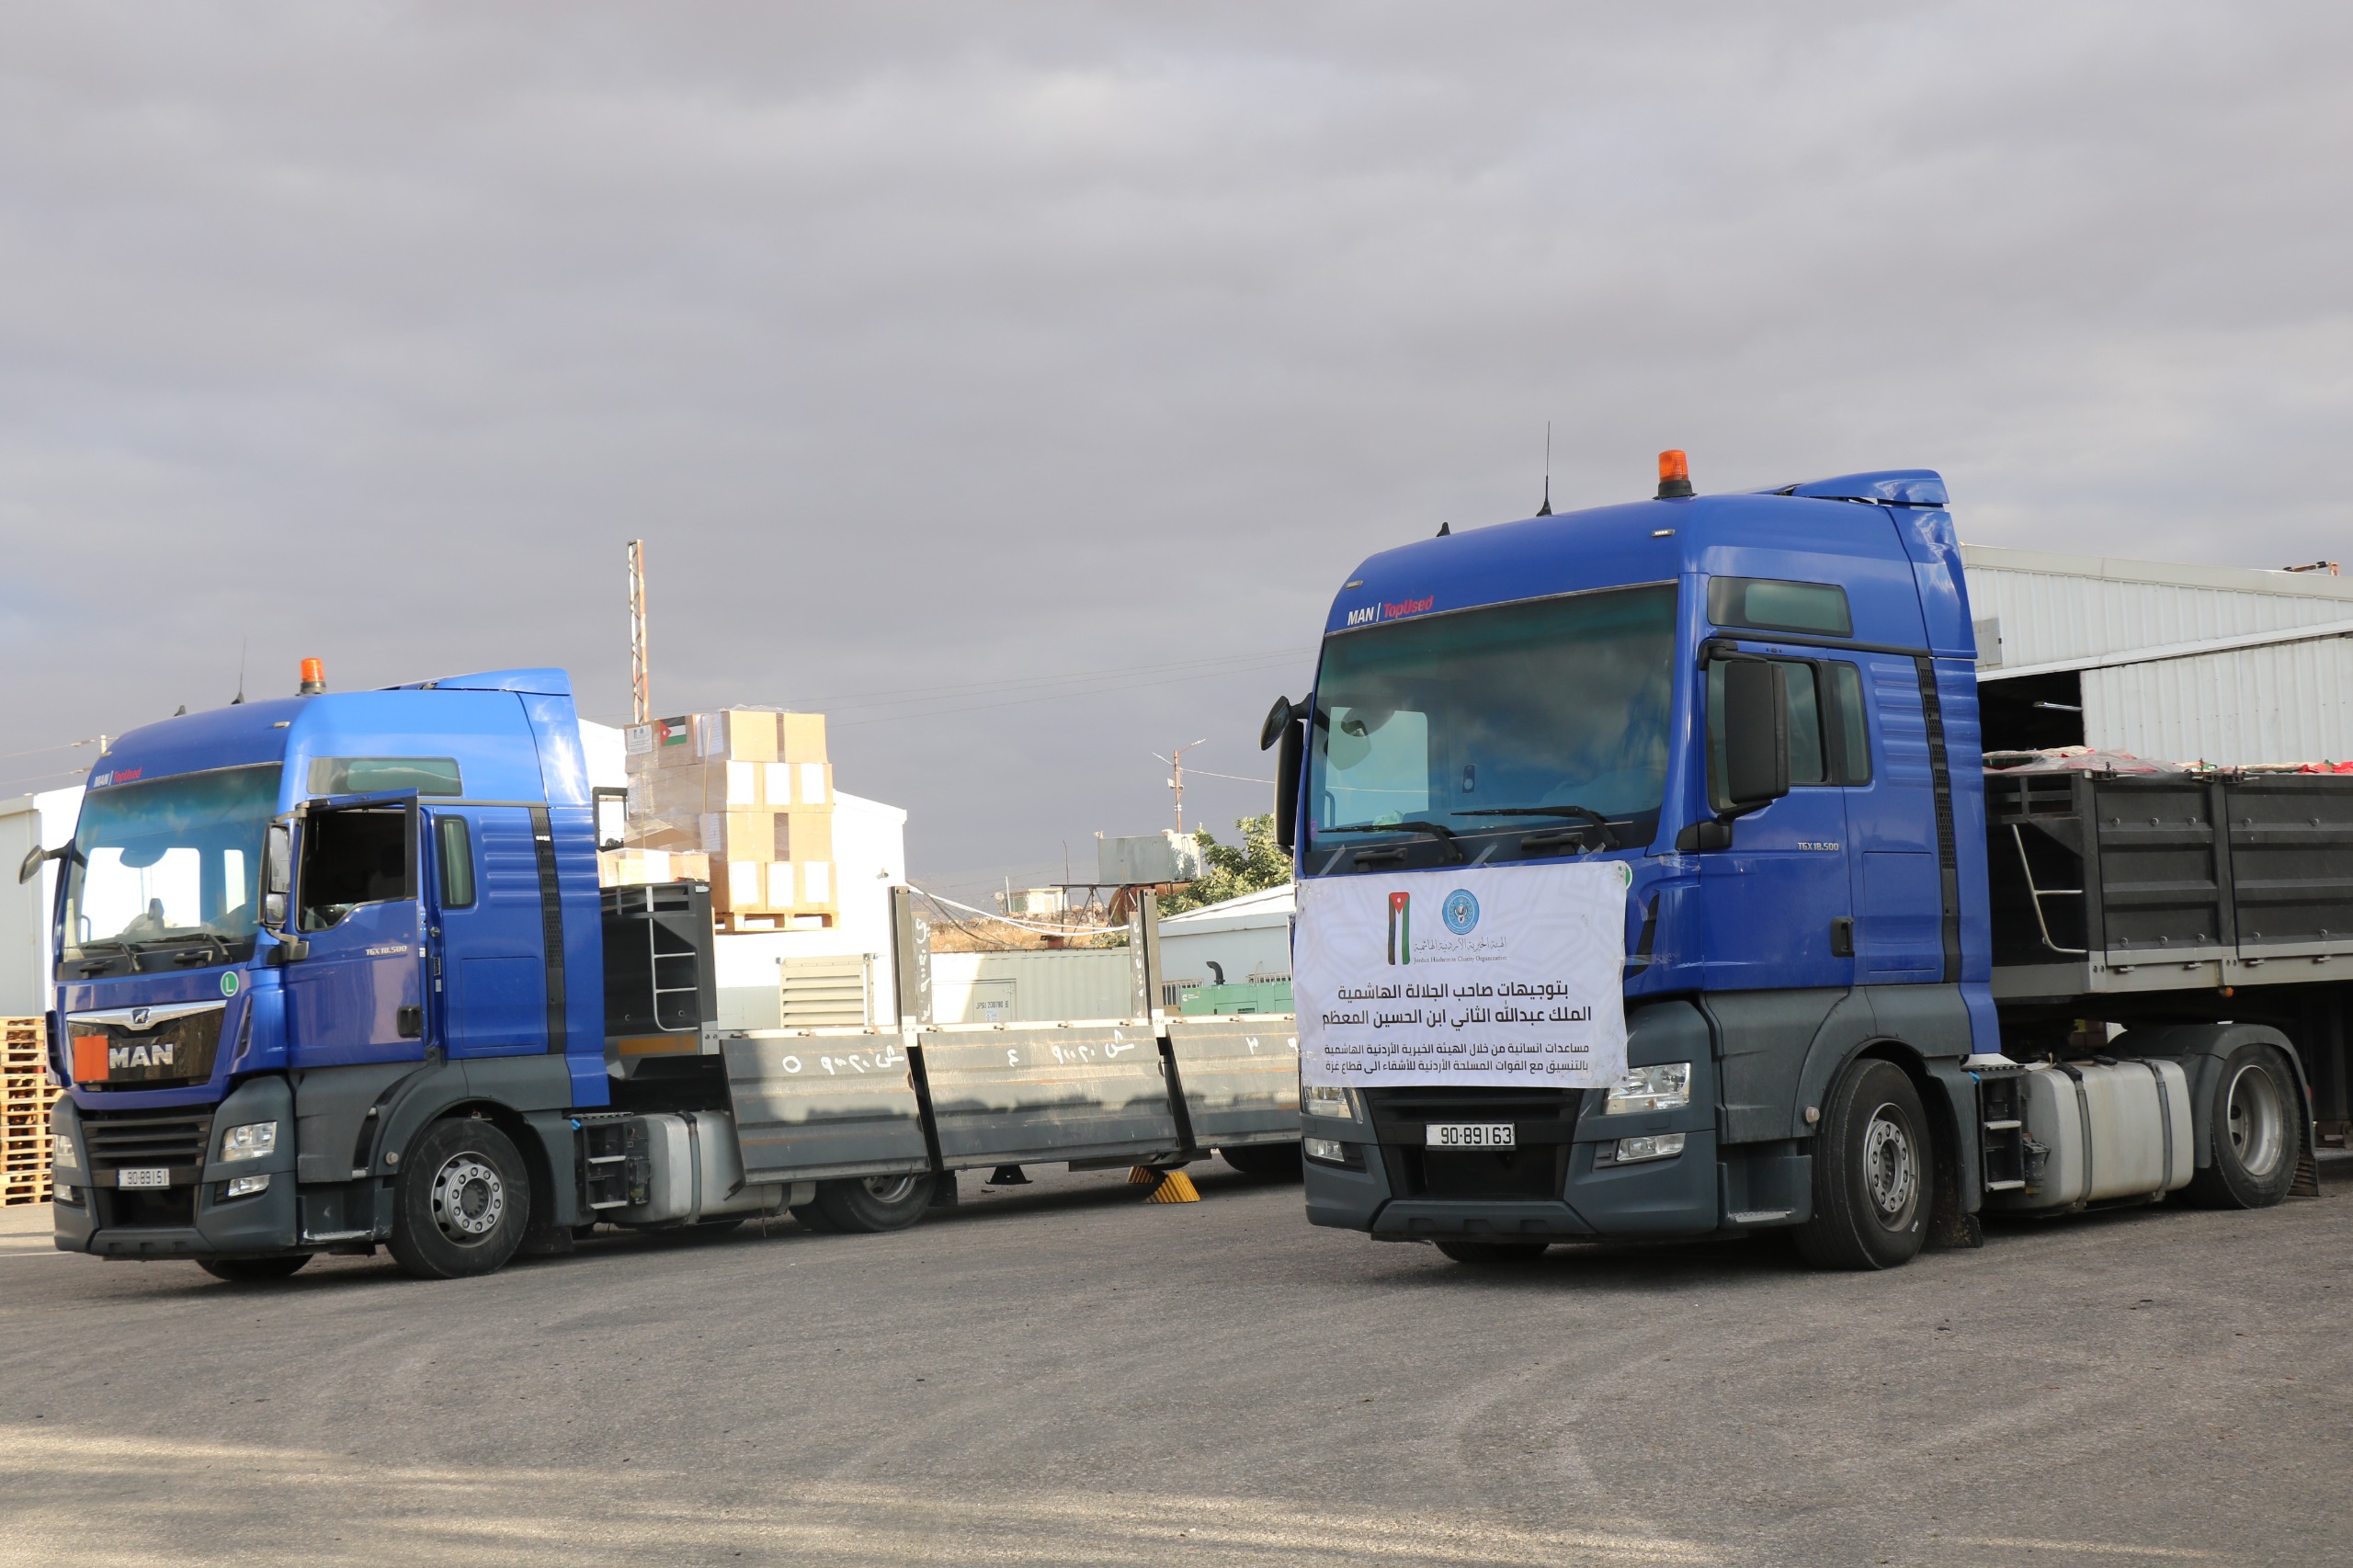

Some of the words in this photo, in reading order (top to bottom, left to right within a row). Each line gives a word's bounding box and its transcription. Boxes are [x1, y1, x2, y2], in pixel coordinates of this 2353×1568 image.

[1347, 606, 1374, 626] MAN
[1384, 595, 1434, 619] TopUsed
[1797, 842, 1813, 851] TGX
[1813, 842, 1839, 851] 18.500
[1414, 938, 1438, 953] الهاشمية
[1467, 937, 1489, 952] الخيرية
[1490, 937, 1507, 951] الهيئة
[1414, 957, 1430, 965] Jordan
[1458, 956, 1475, 964] Charity
[1475, 955, 1507, 963] Organization
[1337, 982, 1402, 1004] الهاشمية
[1405, 983, 1449, 1002] الجلالة
[1452, 983, 1494, 1002] صاحب
[1497, 980, 1568, 1001] بتوجيهات
[1322, 1010, 1369, 1031] المعظم
[1373, 1009, 1423, 1028] الحسين
[1427, 1009, 1446, 1028] ابن
[1450, 1005, 1491, 1032] الثاني
[1549, 1006, 1592, 1022] الملك
[1324, 1042, 1364, 1057] الهاشمية
[1367, 1041, 1400, 1057] الأردنية
[1402, 1043, 1434, 1057] الخيرية
[1436, 1041, 1467, 1056] الهيئة
[1469, 1043, 1489, 1056] خلال
[1491, 1044, 1506, 1056] من
[1507, 1042, 1542, 1056] انسانية
[1545, 1042, 1589, 1053] مساعدات
[108, 1043, 174, 1070] MAN
[1325, 1060, 1340, 1074] غزة
[1341, 1060, 1362, 1074] قطاع
[1364, 1060, 1381, 1074] الى
[1382, 1059, 1416, 1071] للأشقاء
[1418, 1059, 1450, 1074] الأردنية
[1453, 1060, 1493, 1071] المسلحة
[1495, 1060, 1528, 1074] القوات
[1529, 1062, 1544, 1074] مع
[1545, 1060, 1589, 1074] بالتنسيق
